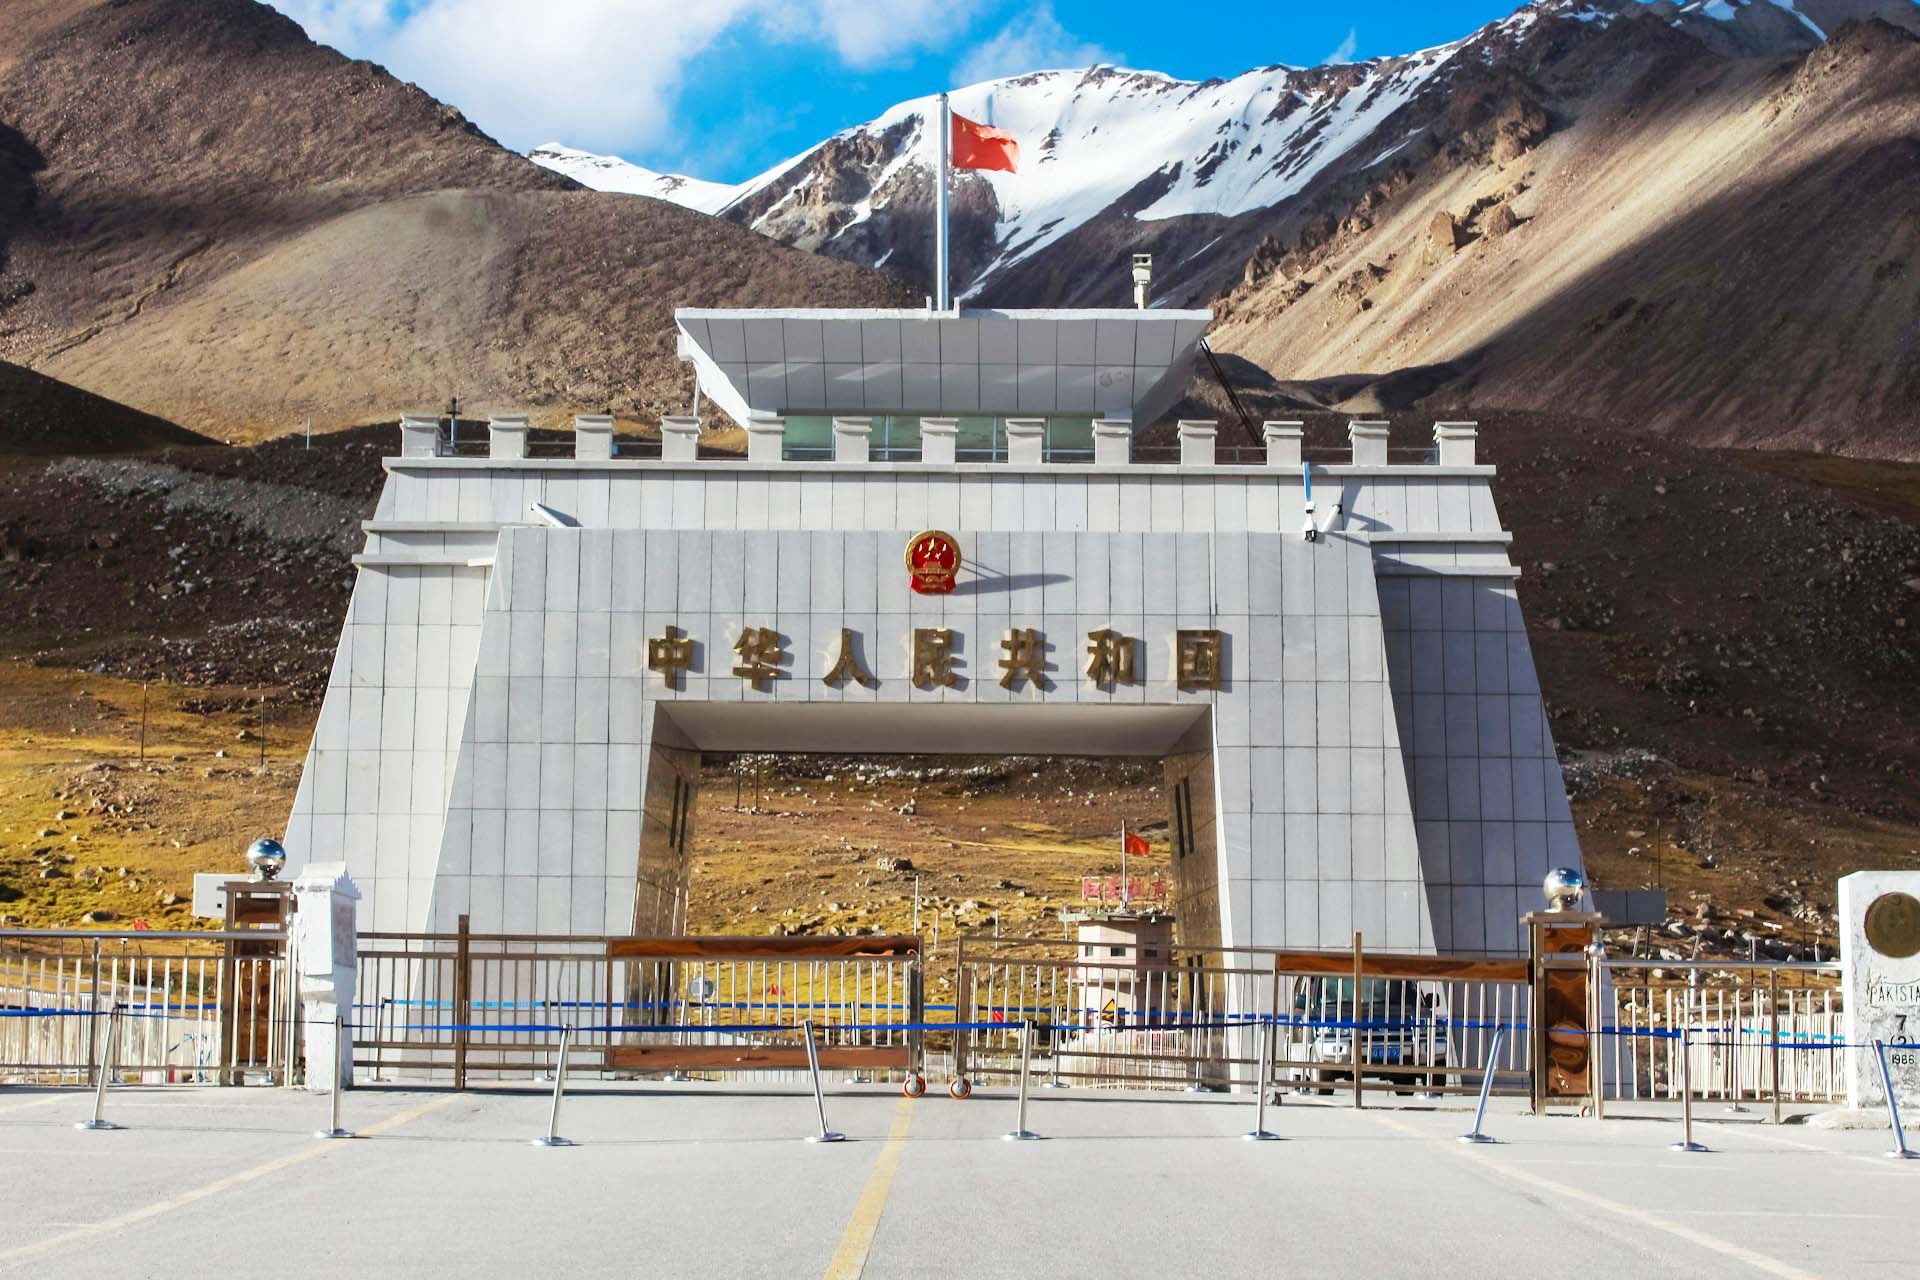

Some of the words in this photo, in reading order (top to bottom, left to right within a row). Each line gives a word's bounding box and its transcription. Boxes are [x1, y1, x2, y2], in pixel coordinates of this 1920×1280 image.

[648, 625, 1222, 692] 中华人民共和国
[1896, 1014, 1908, 1031] 7
